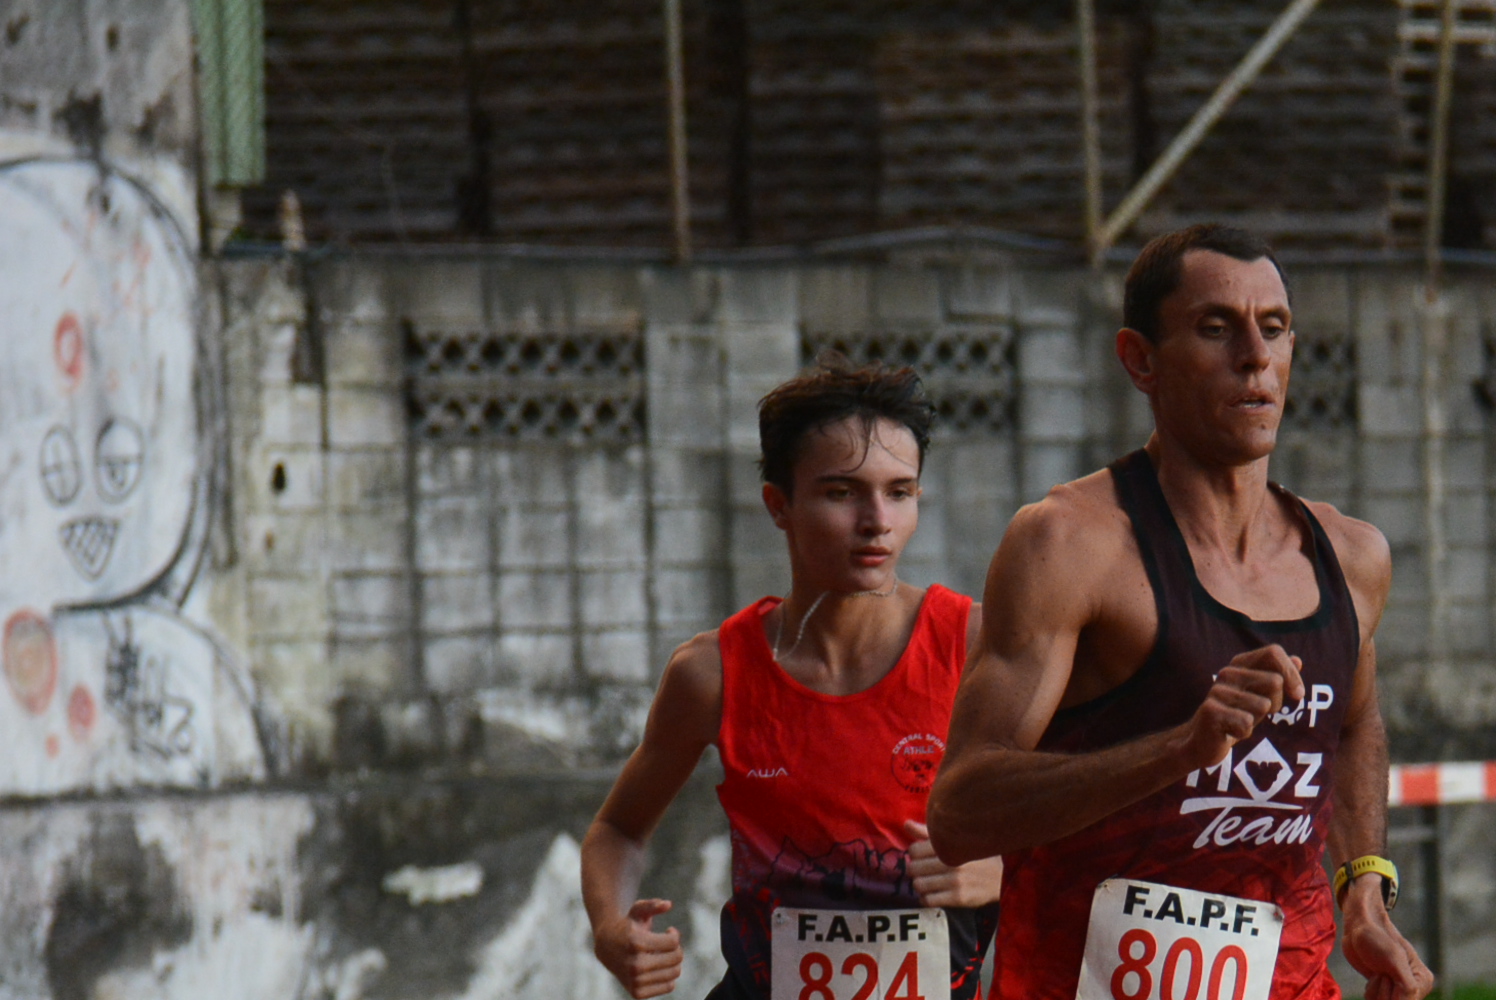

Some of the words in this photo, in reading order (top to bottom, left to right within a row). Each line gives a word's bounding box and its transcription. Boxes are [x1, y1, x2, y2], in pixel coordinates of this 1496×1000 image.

[892, 733, 923, 755] CENTRAL
[1179, 797, 1313, 850] Team
[797, 913, 927, 943] F.A.P.F.
[1122, 884, 1260, 937] F.A.P.F.
